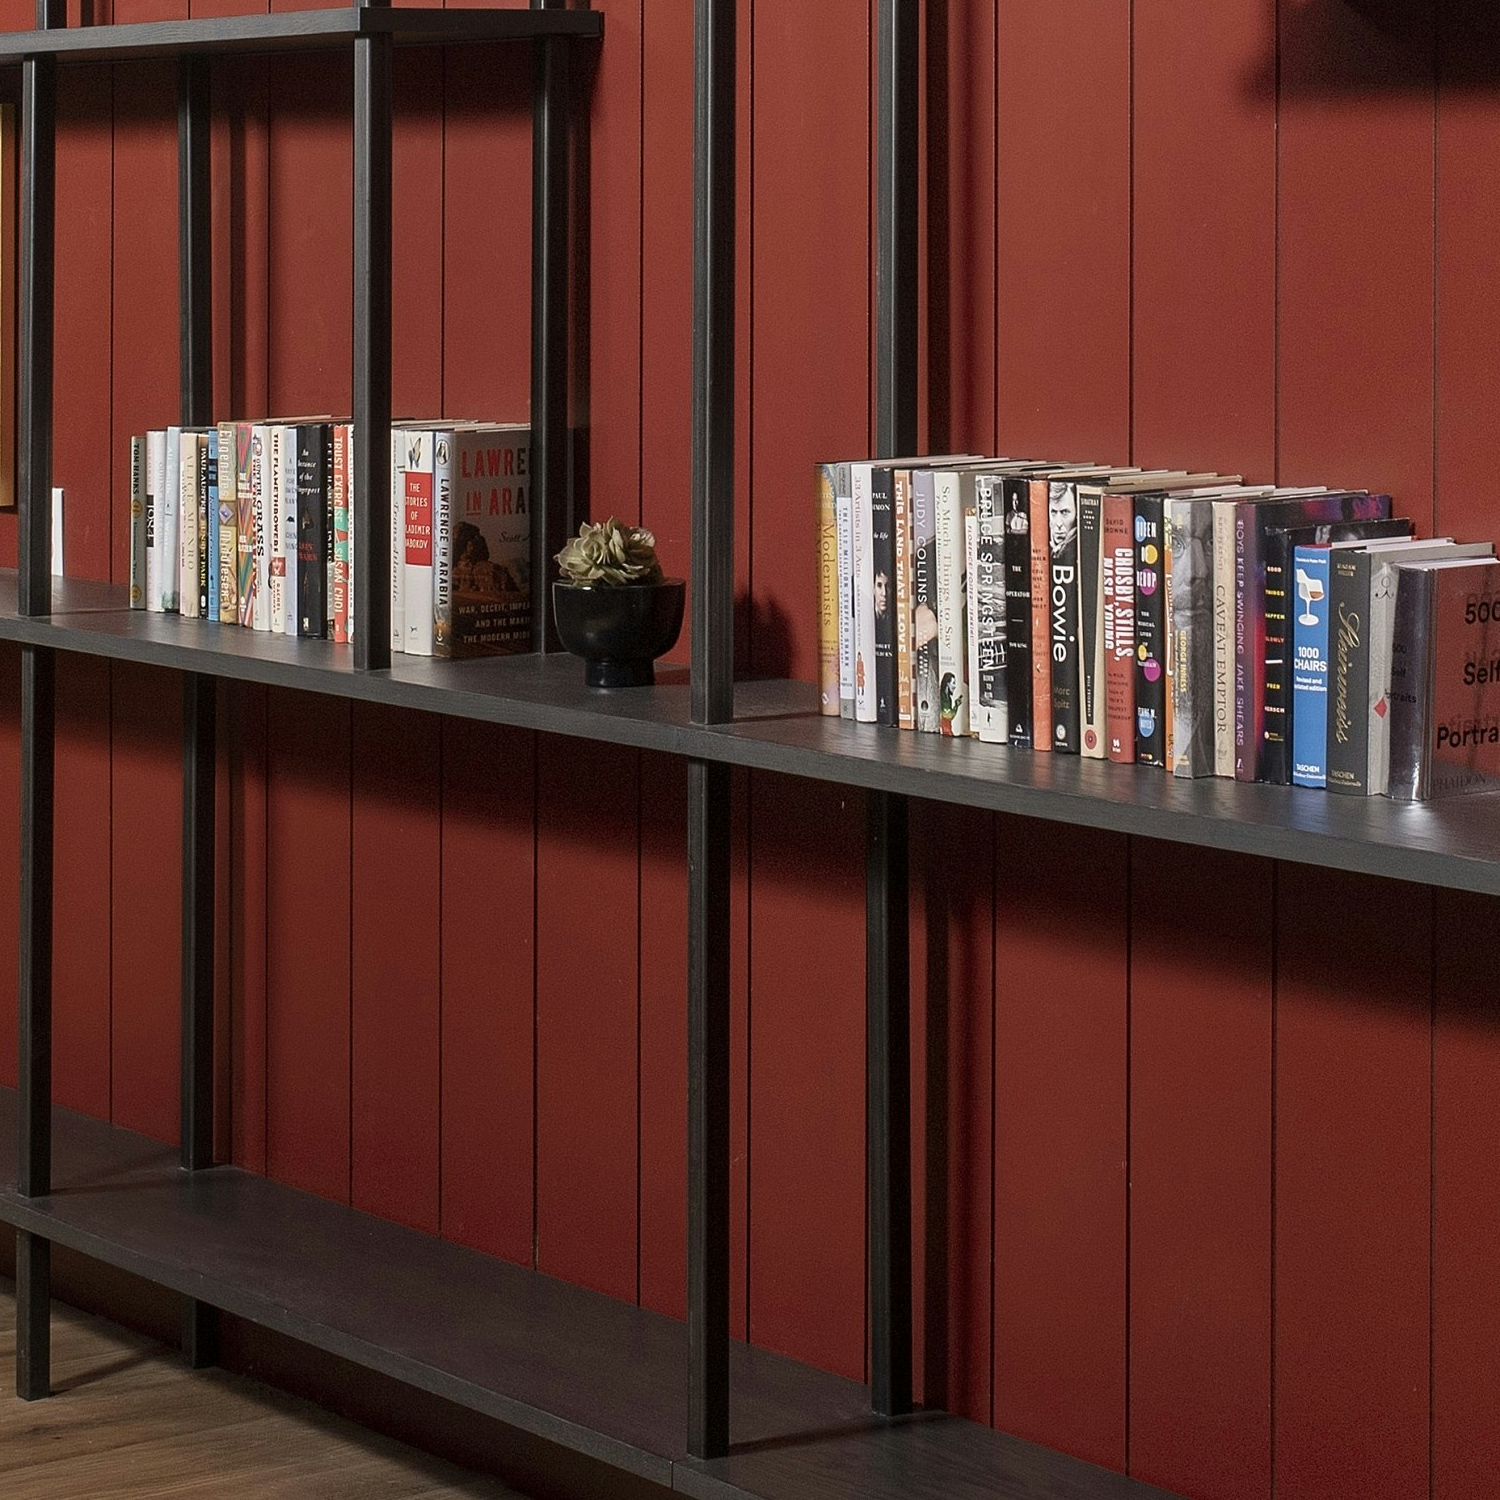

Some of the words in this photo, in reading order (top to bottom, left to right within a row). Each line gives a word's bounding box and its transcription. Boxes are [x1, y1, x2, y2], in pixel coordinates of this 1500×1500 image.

[219, 430, 233, 498] Eugenides
[333, 435, 344, 470] TRUST
[461, 447, 531, 479] LAWRE
[132, 464, 140, 495] HANKS
[186, 454, 195, 502] ALICE
[199, 474, 207, 514] AUSTER
[409, 481, 421, 493] THE
[333, 474, 344, 523] EXERCISE
[439, 478, 450, 542] LAWRENCE
[465, 490, 482, 515] IN
[854, 490, 863, 530] Artists
[895, 480, 905, 514] THIS
[915, 491, 926, 528] JUDY
[941, 485, 951, 506] So
[256, 499, 265, 557] GRASS
[405, 525, 431, 536] LADIMIR
[410, 511, 419, 521] OF
[842, 506, 850, 524] THE
[941, 508, 952, 548] Much
[979, 486, 993, 546] BRUCE
[1105, 518, 1124, 526] DAVID
[186, 511, 195, 571] MUNRO
[440, 546, 449, 557] IN
[854, 532, 863, 543] in
[896, 518, 905, 557] LAND
[1236, 519, 1245, 554] BOYS
[199, 559, 207, 588] PARK
[219, 529, 233, 598] Middlesex
[333, 547, 344, 582] SUSAN
[821, 522, 836, 627] Modernists
[842, 549, 850, 588] MILLION
[855, 556, 863, 579] Acts
[916, 535, 928, 604] COLLINS
[941, 551, 953, 603] Things
[1011, 565, 1022, 573] THE
[1103, 557, 1114, 596] NASH
[1113, 547, 1135, 607] CROSBY,
[1236, 557, 1245, 588] KEEP
[437, 560, 449, 607] ARABIA
[896, 561, 906, 600] THAT
[1265, 589, 1285, 597] THINGS
[333, 587, 344, 613] CHOI
[843, 593, 851, 635] STUFFED
[943, 606, 953, 620] to
[980, 551, 994, 670] SPRINGSTEEN
[1052, 565, 1076, 663] Bowie
[1265, 612, 1285, 620] HAPPEN
[475, 619, 491, 629] AND
[898, 608, 907, 654] LOVE
[1104, 603, 1115, 650] YOUNG
[1113, 607, 1135, 662] STILLS,
[1215, 584, 1227, 655] CAVEAT
[1236, 590, 1245, 655] SWINGING
[463, 634, 478, 644] THE
[480, 632, 511, 644] MODERN
[843, 638, 851, 667] SHARK
[942, 626, 954, 650] Say
[1179, 630, 1188, 663] GEORGE
[1265, 636, 1285, 644] SLOWLY
[1298, 646, 1320, 658] 1000
[1393, 643, 1408, 655] 500
[1179, 663, 1188, 693] INNESS
[1236, 663, 1245, 692] JAKE
[1294, 660, 1328, 672] CHAIRS
[1312, 677, 1323, 685] and
[1334, 602, 1361, 744] Steinweiss
[1391, 666, 1408, 678] Self
[1215, 660, 1228, 735] EMPTOR
[1266, 682, 1281, 690] FRED
[1236, 697, 1245, 746] SHEARS
[1264, 705, 1286, 714] HERSCH
[1296, 763, 1320, 773] TASCHEN
[1331, 769, 1355, 781] TASCHEN
